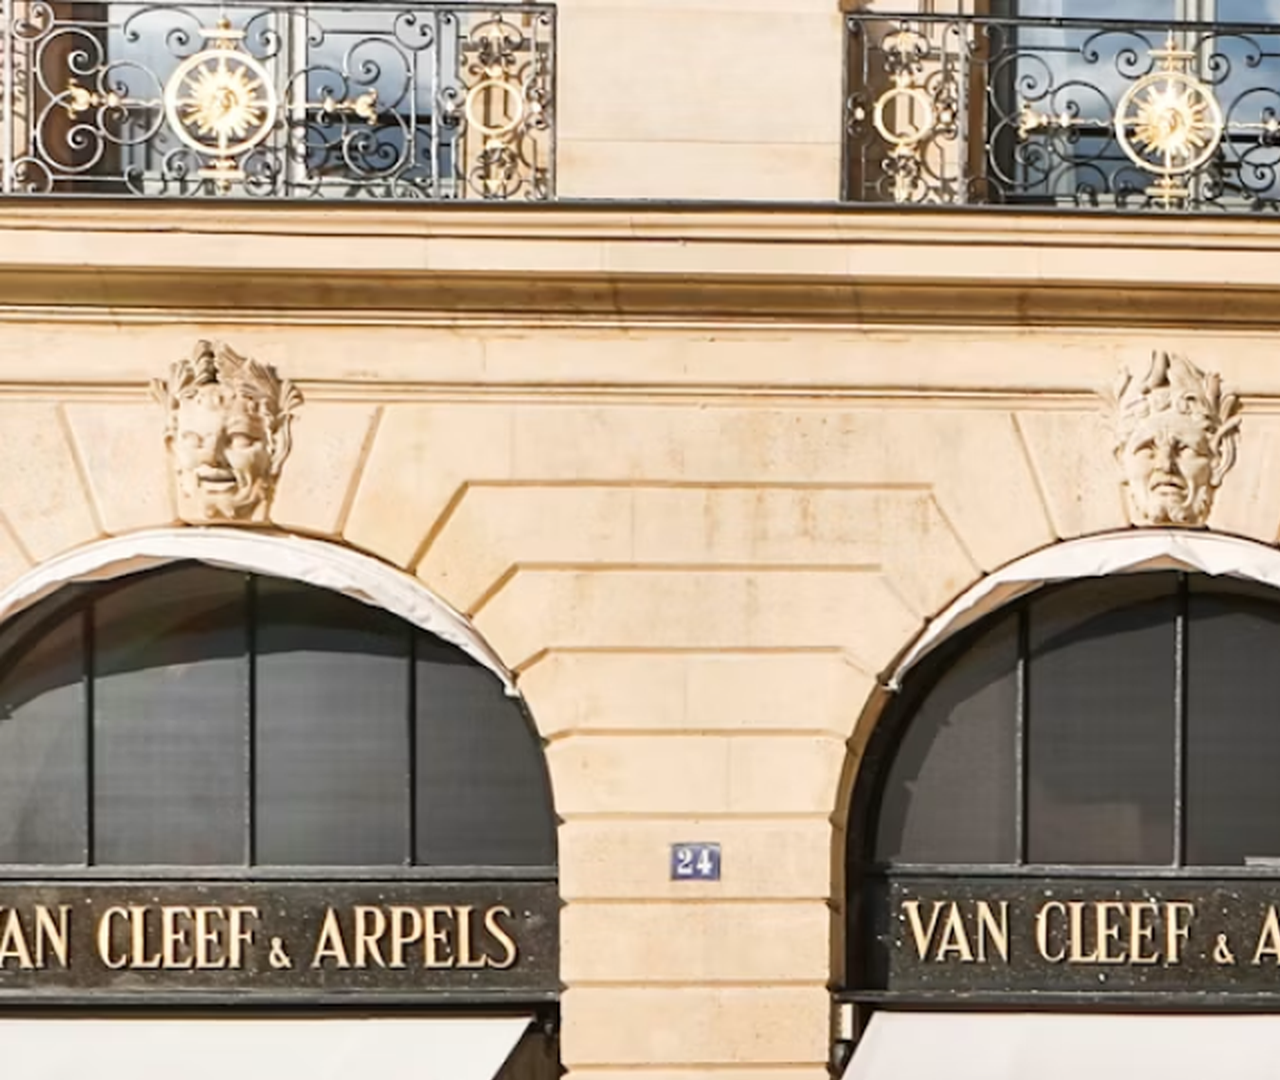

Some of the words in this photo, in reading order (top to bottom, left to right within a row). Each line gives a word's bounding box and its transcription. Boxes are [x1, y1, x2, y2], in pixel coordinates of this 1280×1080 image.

[677, 848, 712, 875] 24
[0, 905, 71, 969] AN
[97, 905, 259, 970] CLEEF
[269, 936, 292, 969] &
[311, 905, 518, 969] ARPELS
[901, 901, 1010, 964] VAN
[1036, 902, 1194, 965] CLEEF
[1214, 933, 1235, 964] &
